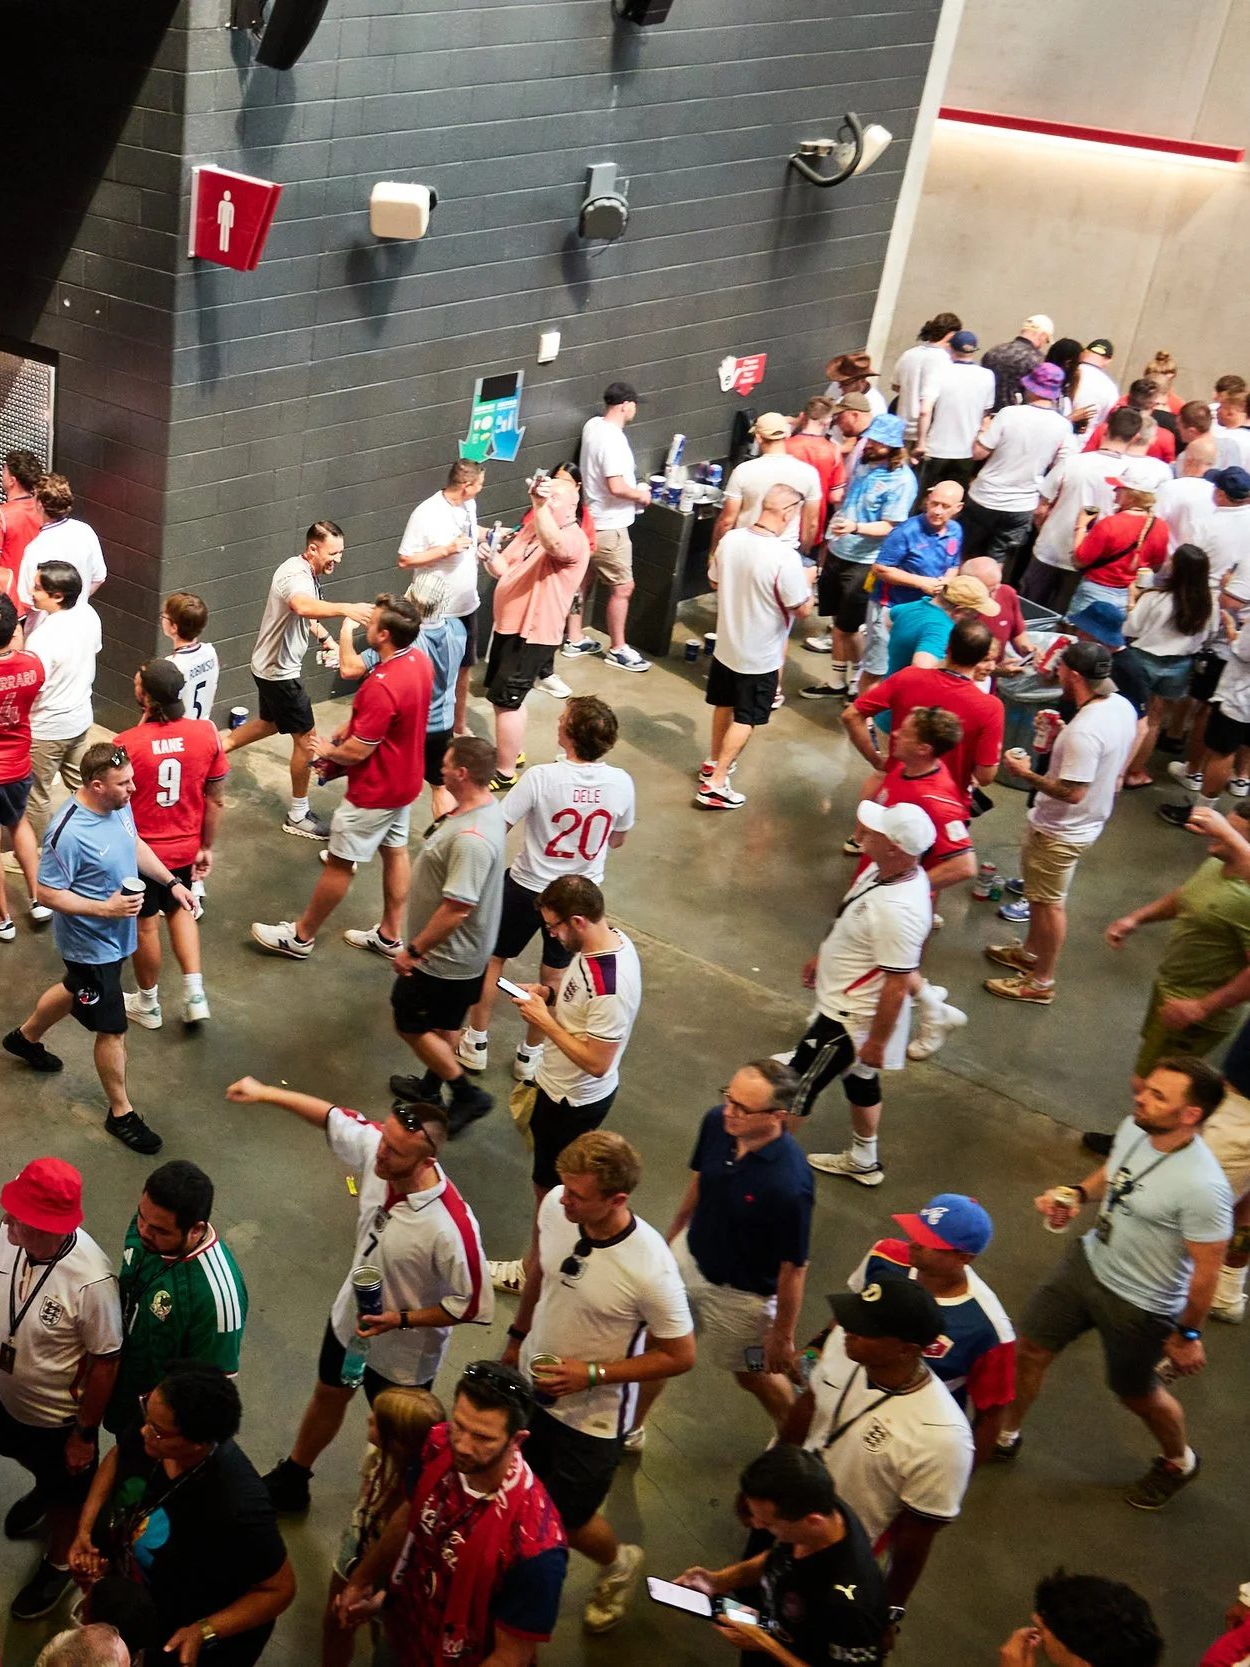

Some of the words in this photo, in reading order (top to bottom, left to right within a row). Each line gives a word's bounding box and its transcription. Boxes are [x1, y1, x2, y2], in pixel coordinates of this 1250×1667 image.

[193, 680, 207, 720] 5
[151, 737, 185, 755] KANE
[156, 757, 182, 808] 9
[573, 789, 601, 803] DELE
[544, 807, 613, 861] 20
[363, 1232, 379, 1257] 7
